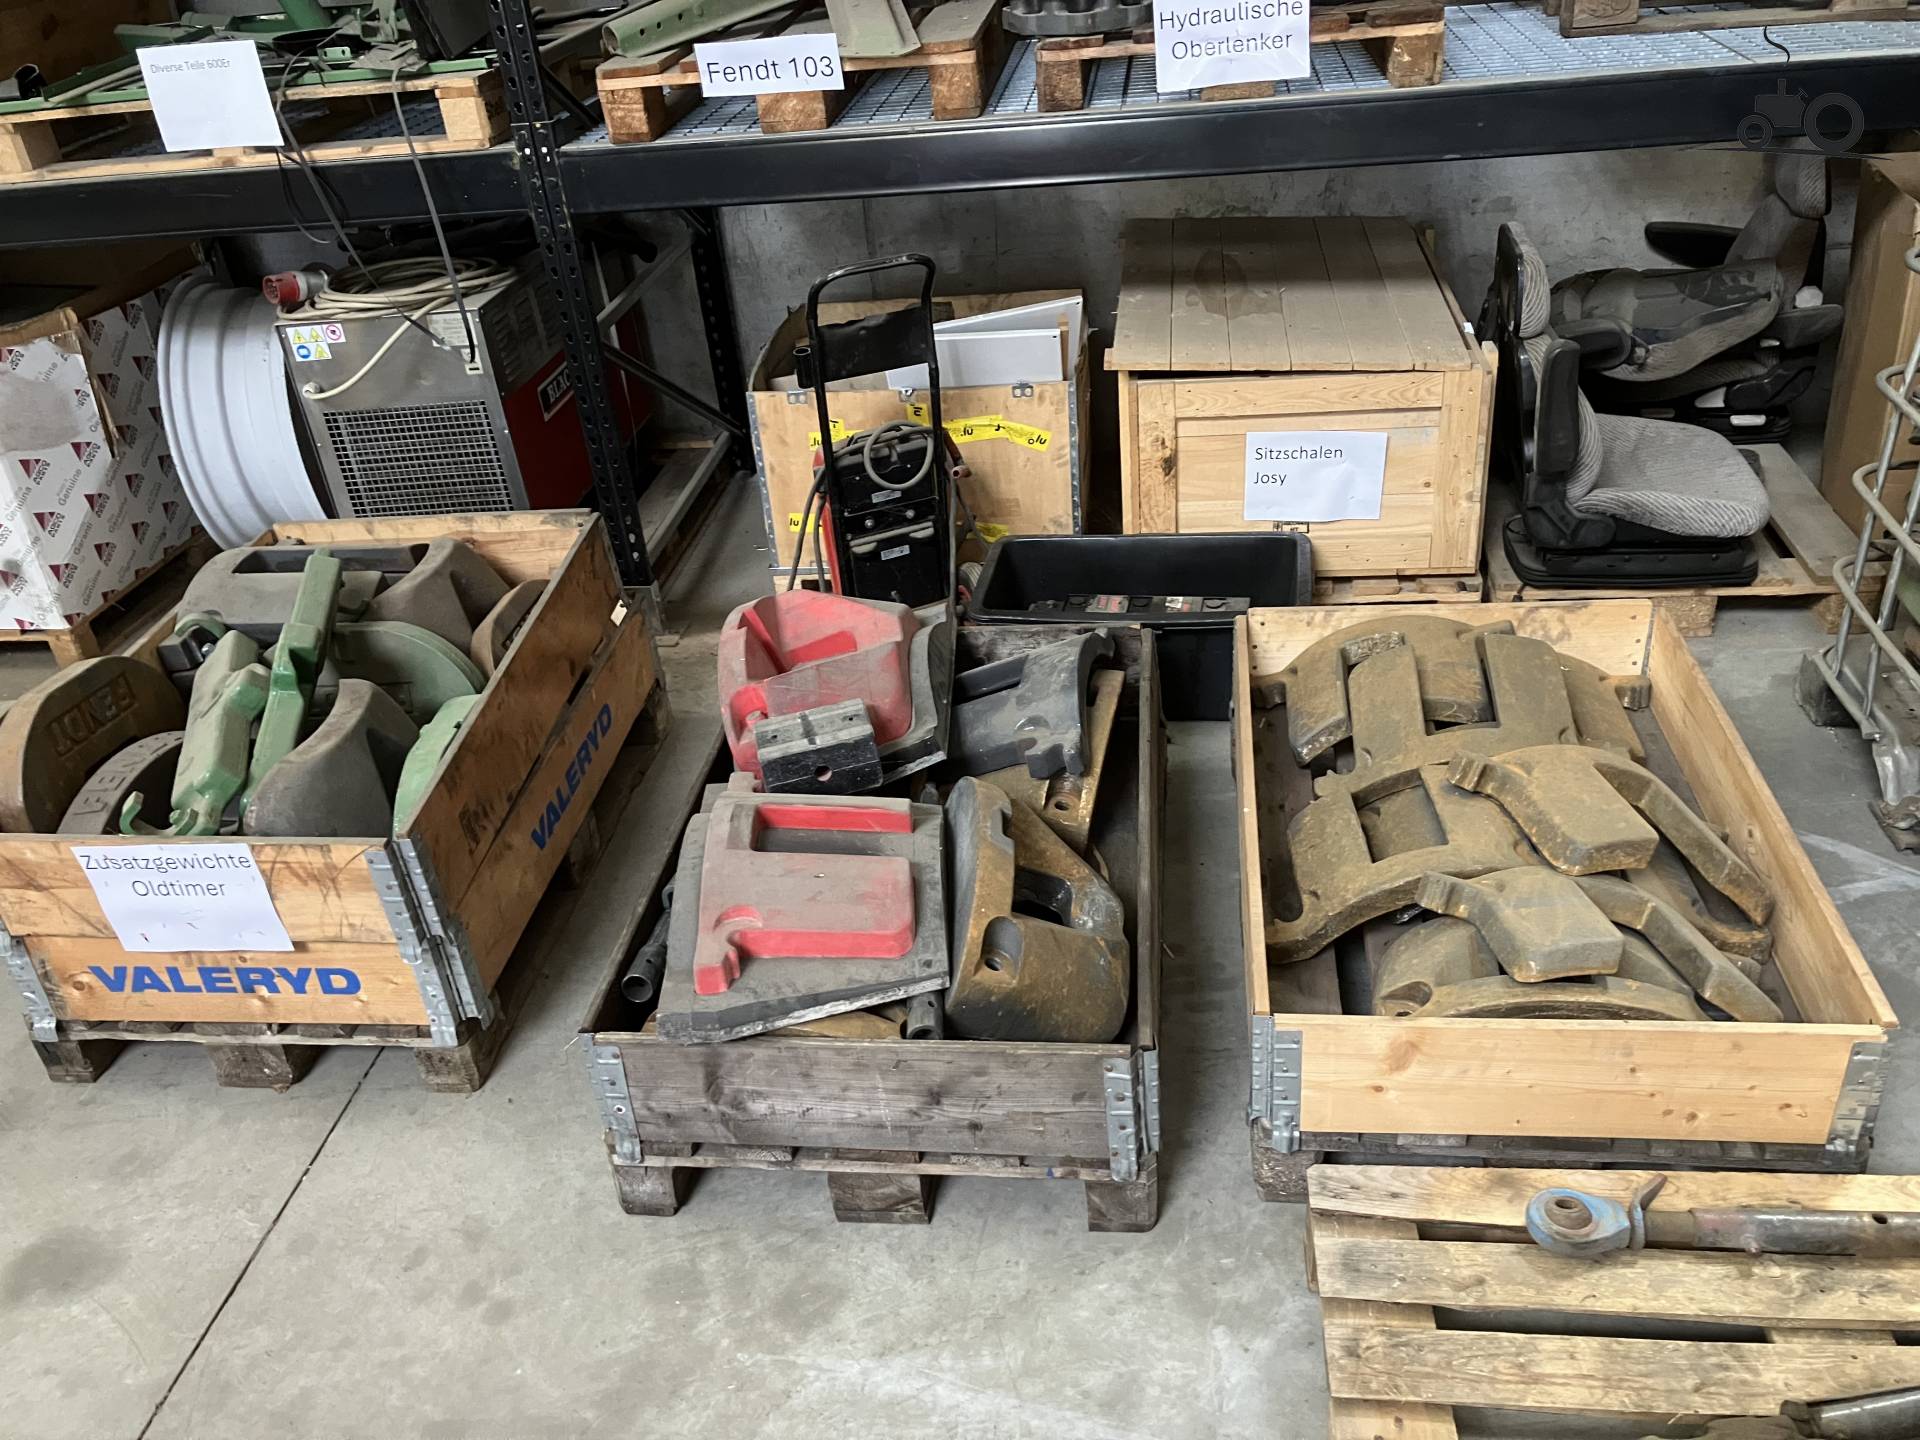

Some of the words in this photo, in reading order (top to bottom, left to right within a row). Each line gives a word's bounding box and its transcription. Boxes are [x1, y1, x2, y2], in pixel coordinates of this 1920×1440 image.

[1159, 0, 1303, 33] Hydraulische
[1172, 33, 1293, 60] Oberlenker
[149, 64, 184, 74] Diverse
[184, 60, 206, 71] Teile
[706, 59, 781, 84] Fendt
[788, 56, 834, 79] 103
[1255, 446, 1343, 460] Sitzschalen
[1254, 472, 1287, 486] Josy
[531, 703, 612, 850] VALERYD
[80, 853, 250, 873] Zusatzgewichte
[132, 879, 226, 897] Oldtimer
[88, 965, 361, 996] VALERYD
